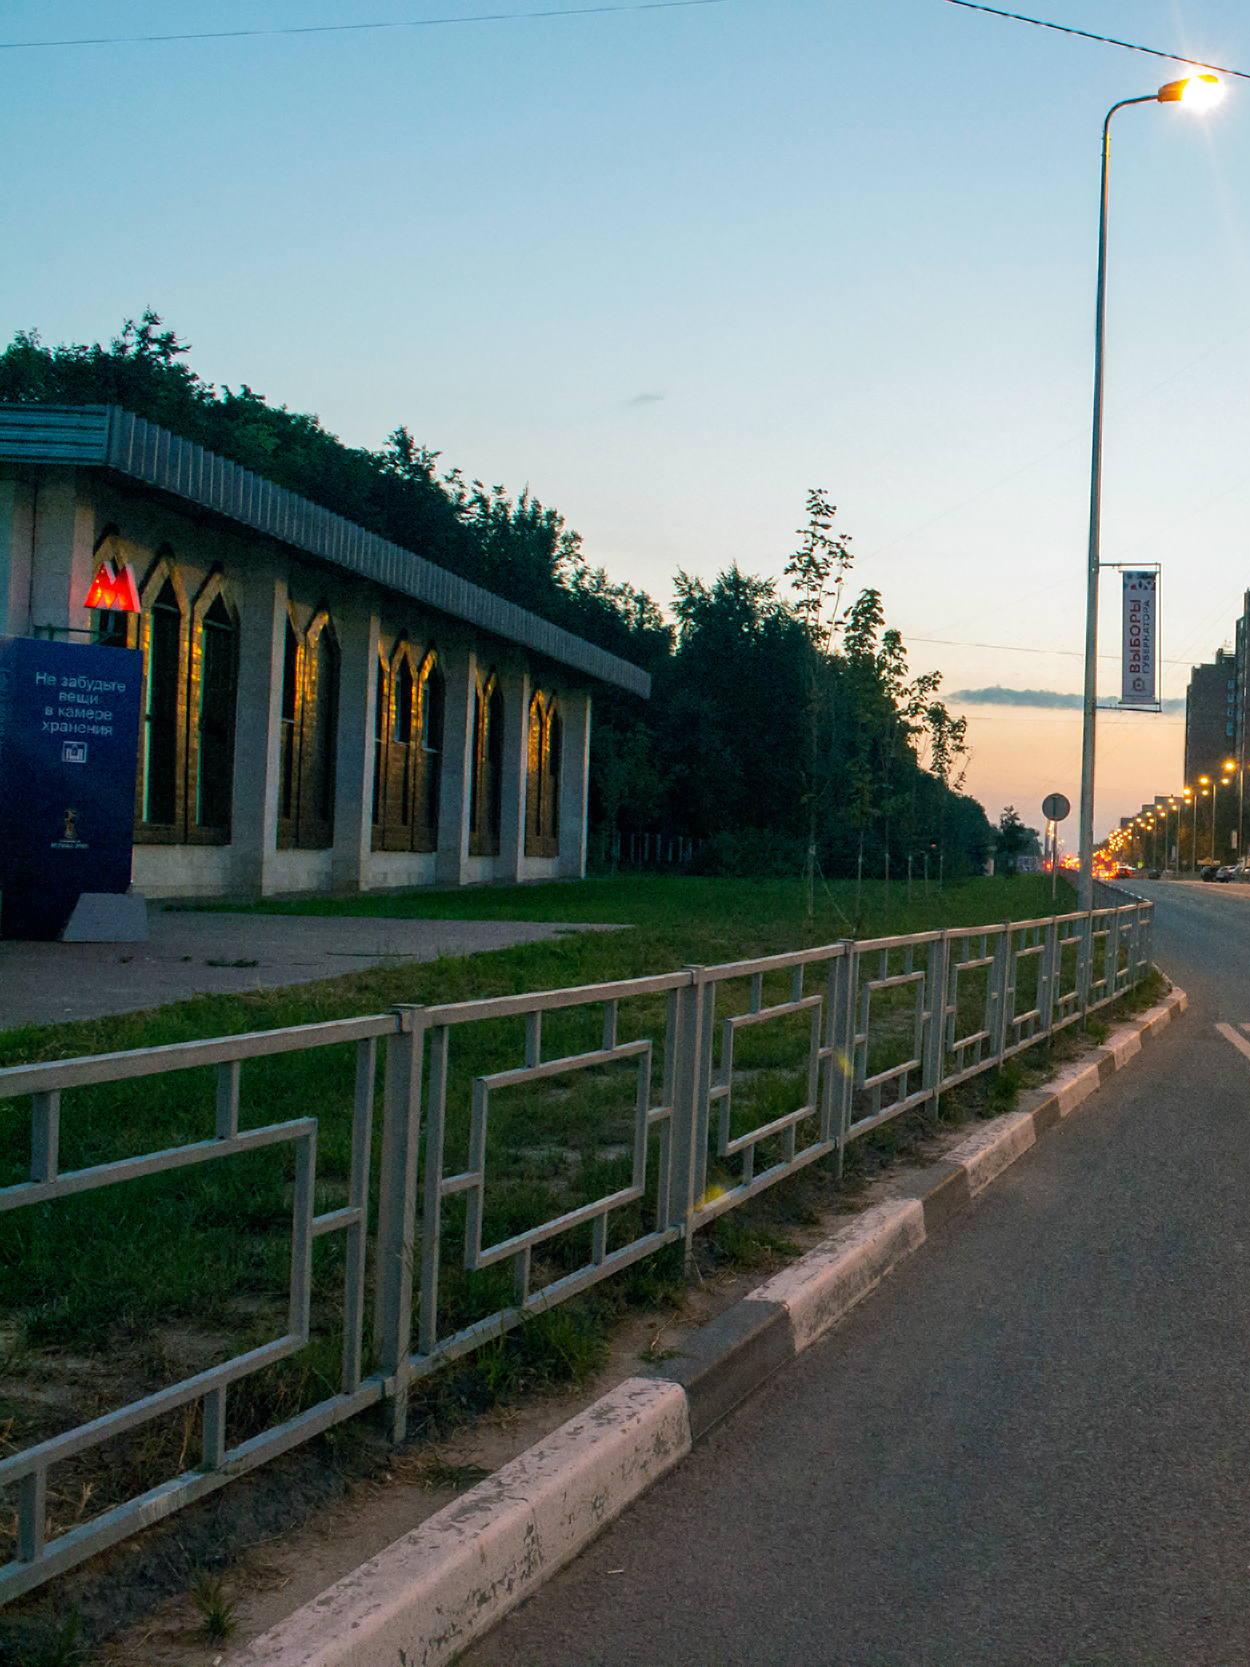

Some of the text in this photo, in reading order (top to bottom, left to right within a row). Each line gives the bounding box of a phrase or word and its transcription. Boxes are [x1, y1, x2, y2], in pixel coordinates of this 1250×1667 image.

[1129, 599, 1141, 674] ВЫБОРЫ
[1142, 600, 1150, 674] ГУБЕРНАТОРА
[35, 671, 126, 692] Не забудьте
[59, 692, 99, 705] вещи
[44, 706, 112, 722] в камере
[42, 721, 113, 736] хранения
